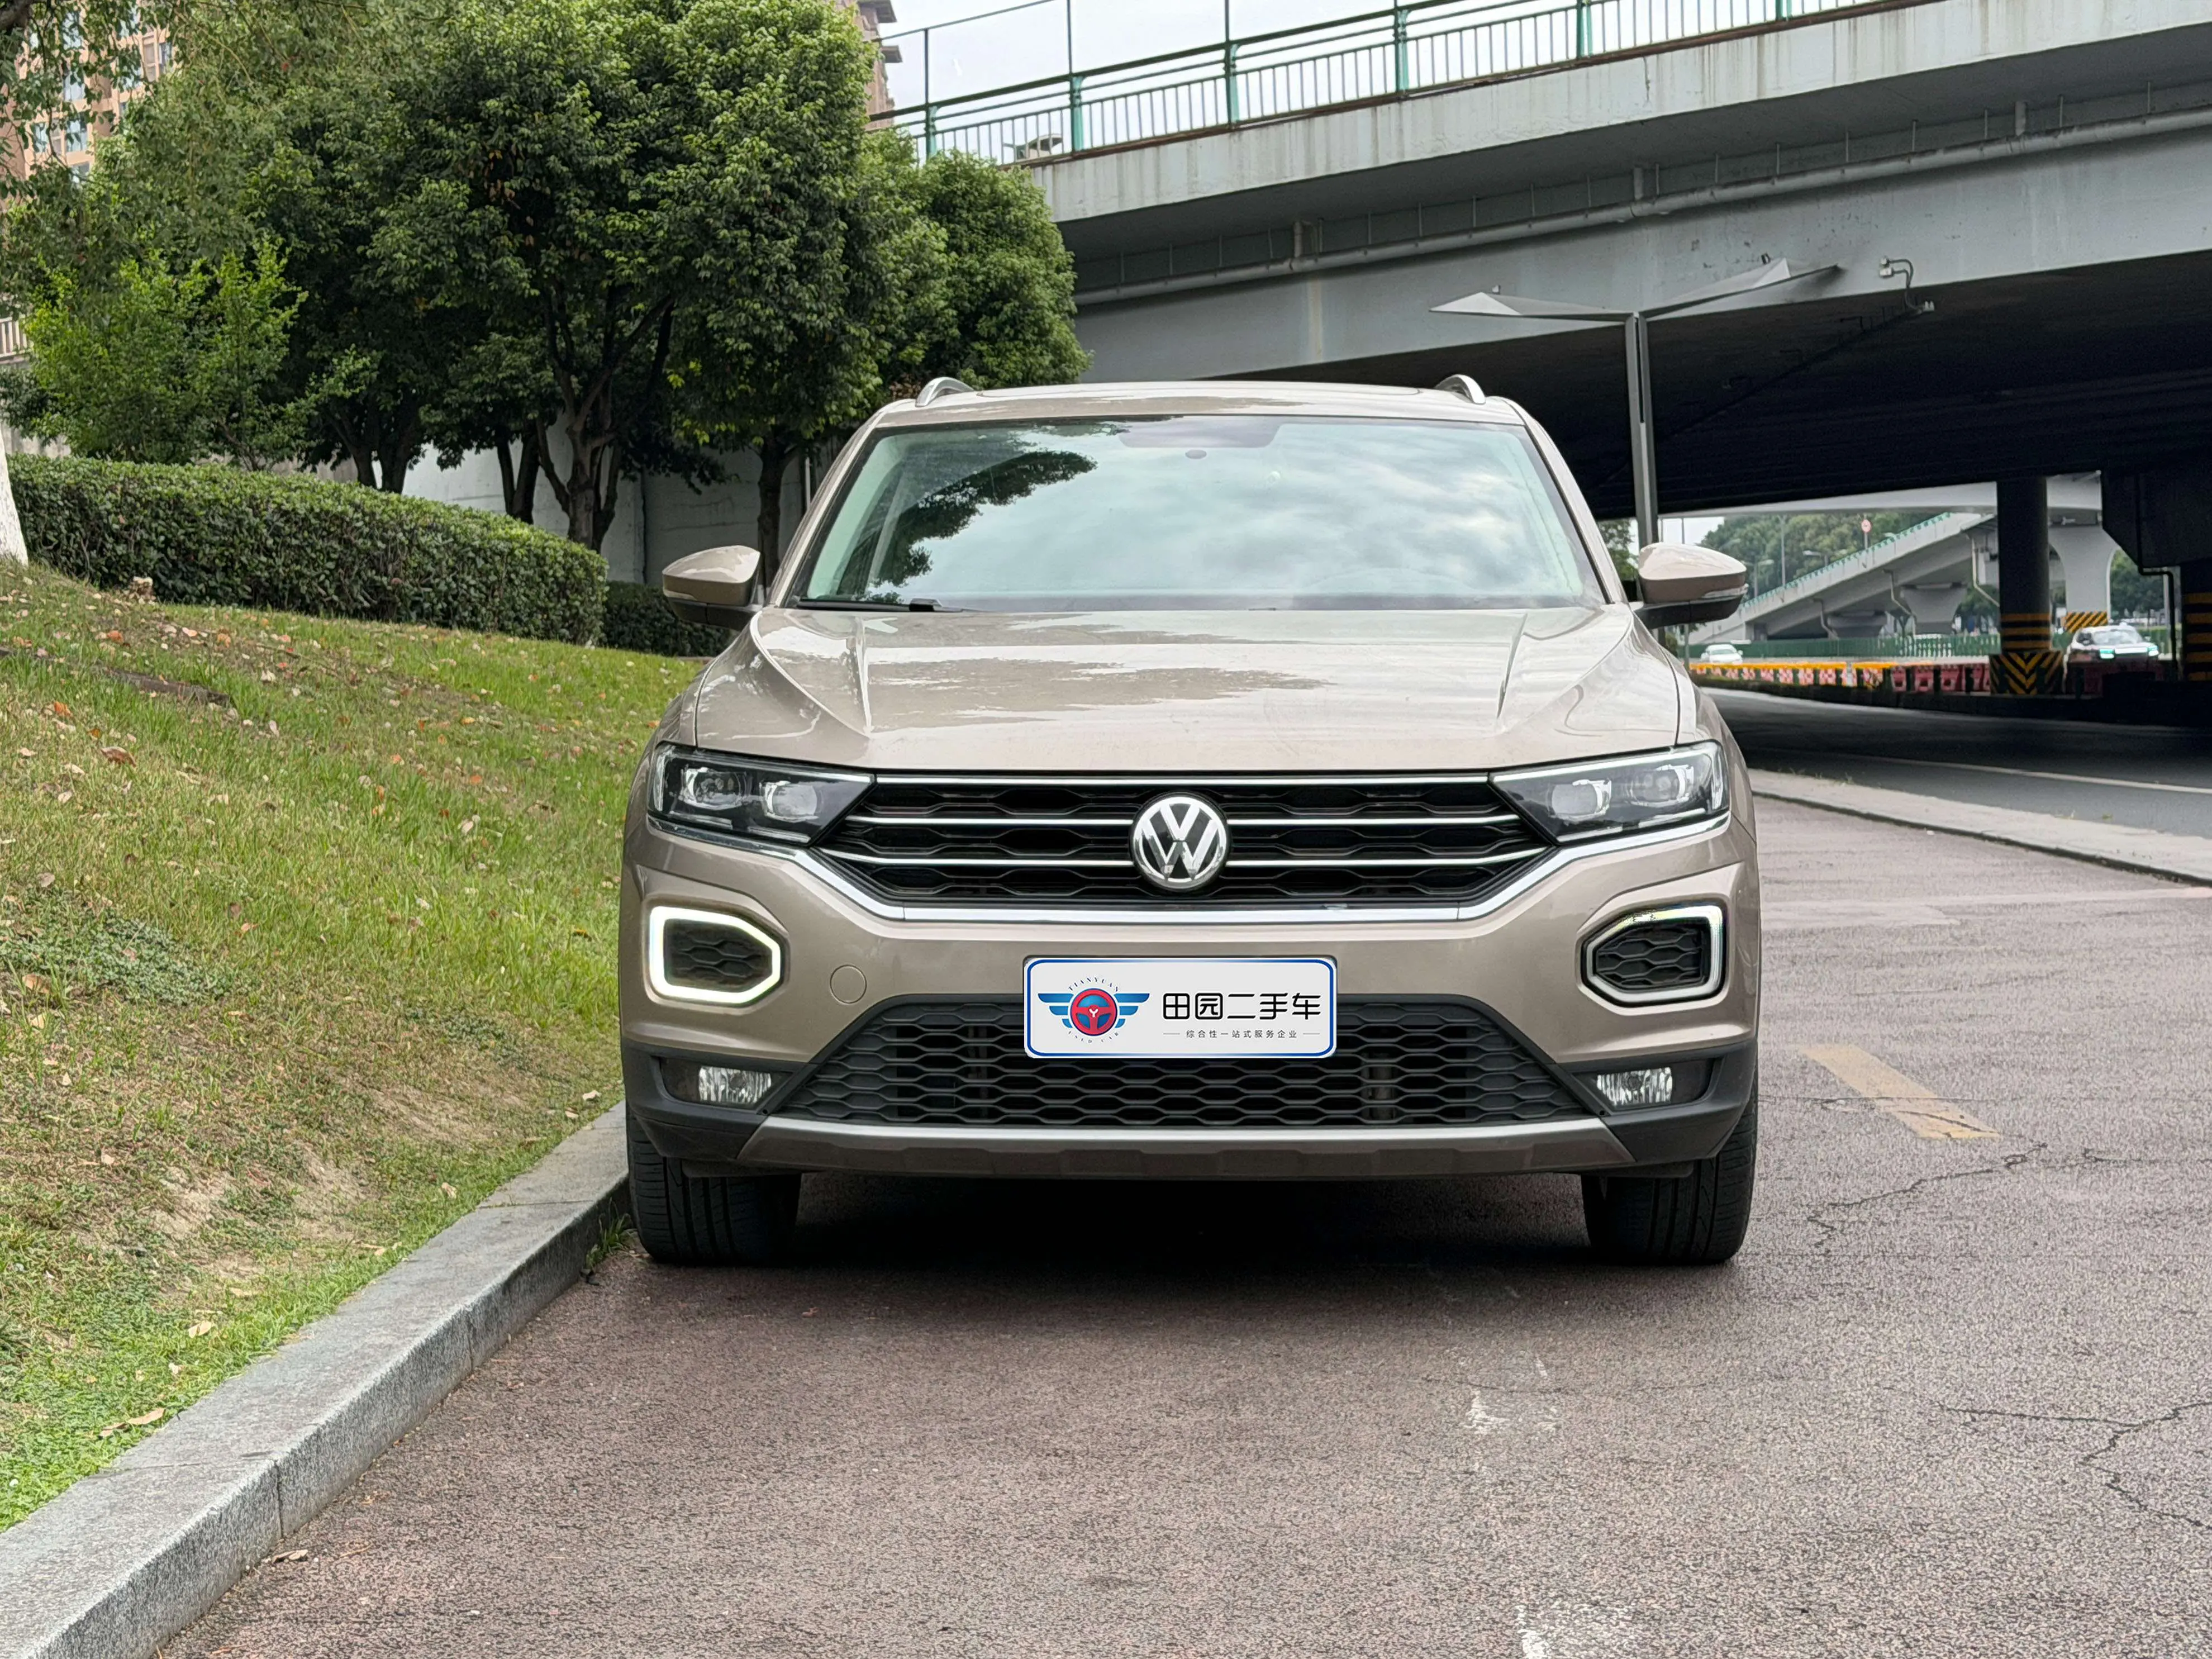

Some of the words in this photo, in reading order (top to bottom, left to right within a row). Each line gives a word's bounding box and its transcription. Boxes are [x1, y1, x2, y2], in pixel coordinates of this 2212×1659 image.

[1136, 800, 1222, 884] VW
[1163, 992, 1321, 1020] 田园二手车
[1186, 1029, 1297, 1039] 综合性一站式服务企业
